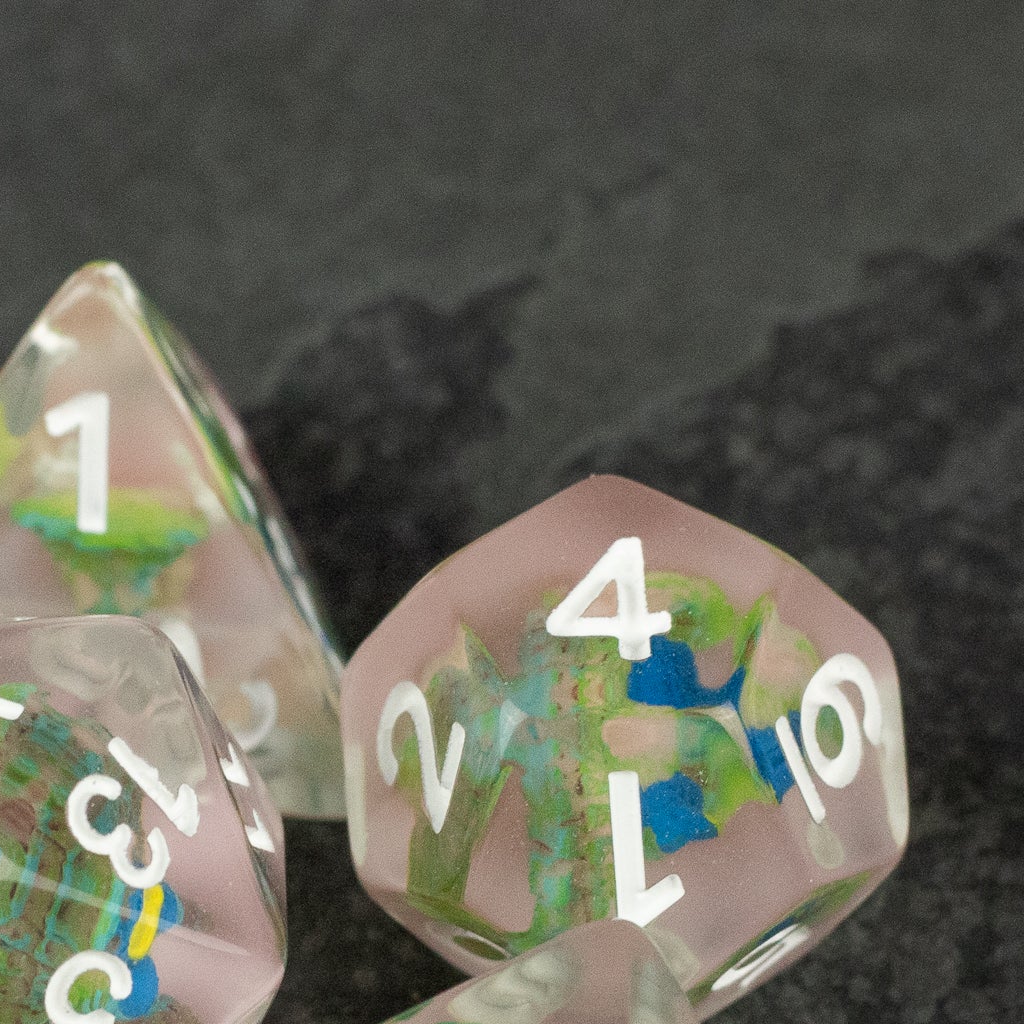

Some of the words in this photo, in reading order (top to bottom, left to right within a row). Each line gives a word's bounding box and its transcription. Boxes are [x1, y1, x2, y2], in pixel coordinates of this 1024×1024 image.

[45, 393, 110, 534] 1
[546, 536, 672, 660] 4
[67, 736, 202, 890] 13
[378, 681, 466, 834] 2
